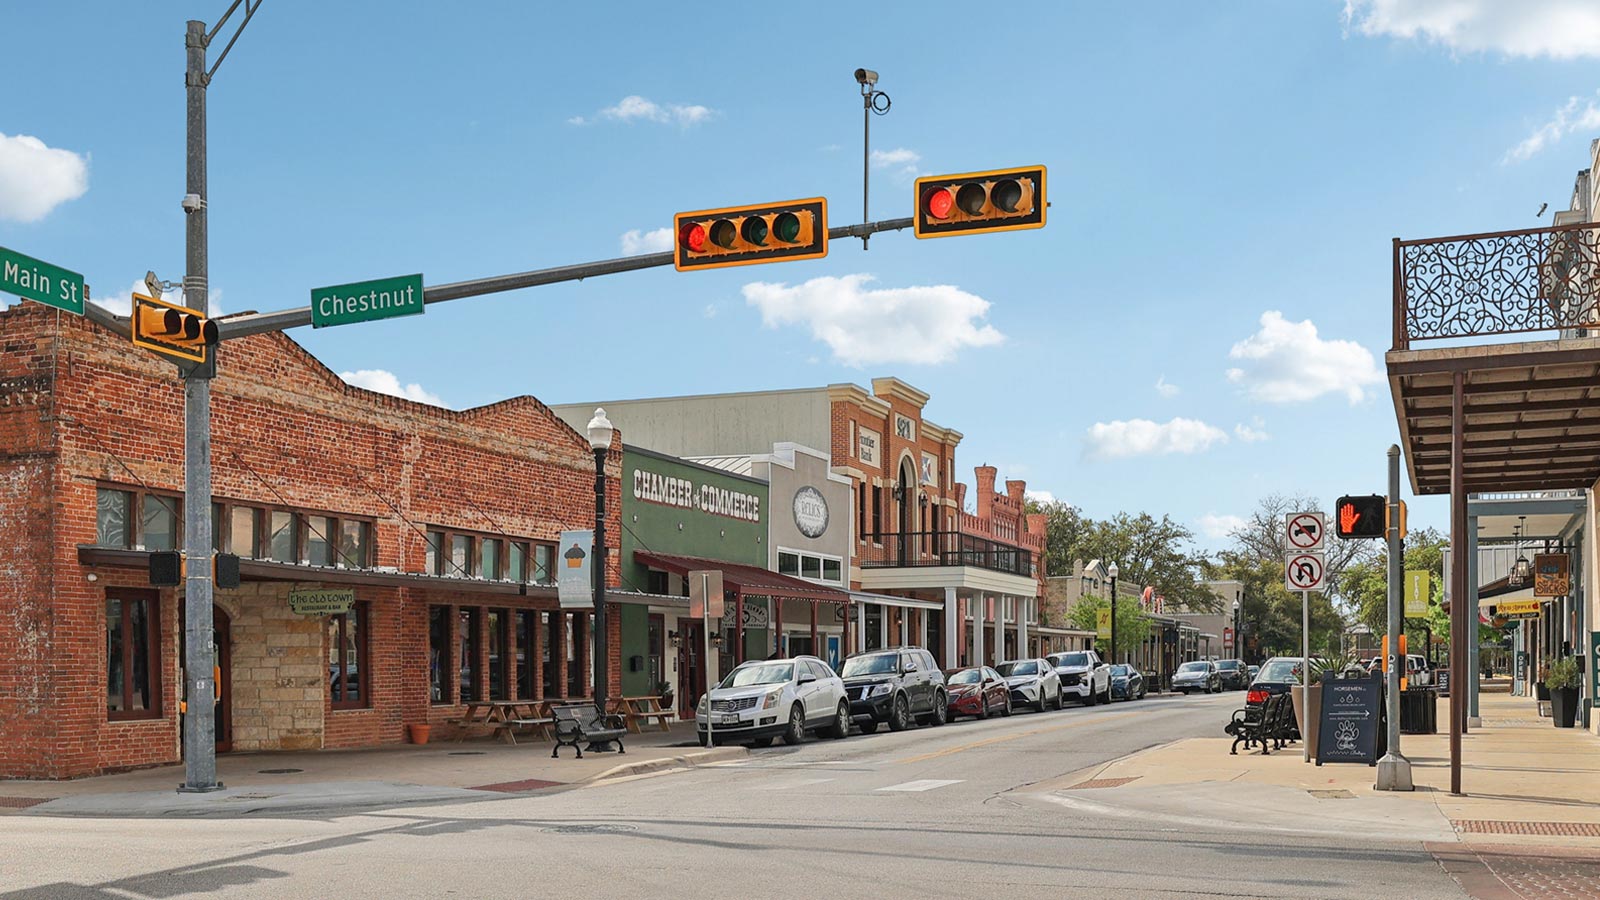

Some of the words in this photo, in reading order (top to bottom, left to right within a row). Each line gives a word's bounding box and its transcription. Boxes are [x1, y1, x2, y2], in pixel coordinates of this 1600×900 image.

[4, 260, 50, 294] Main
[60, 279, 77, 303] St
[320, 285, 414, 316] Chestnut
[633, 469, 692, 508] CHAMBER
[701, 484, 759, 521] COMMERCE
